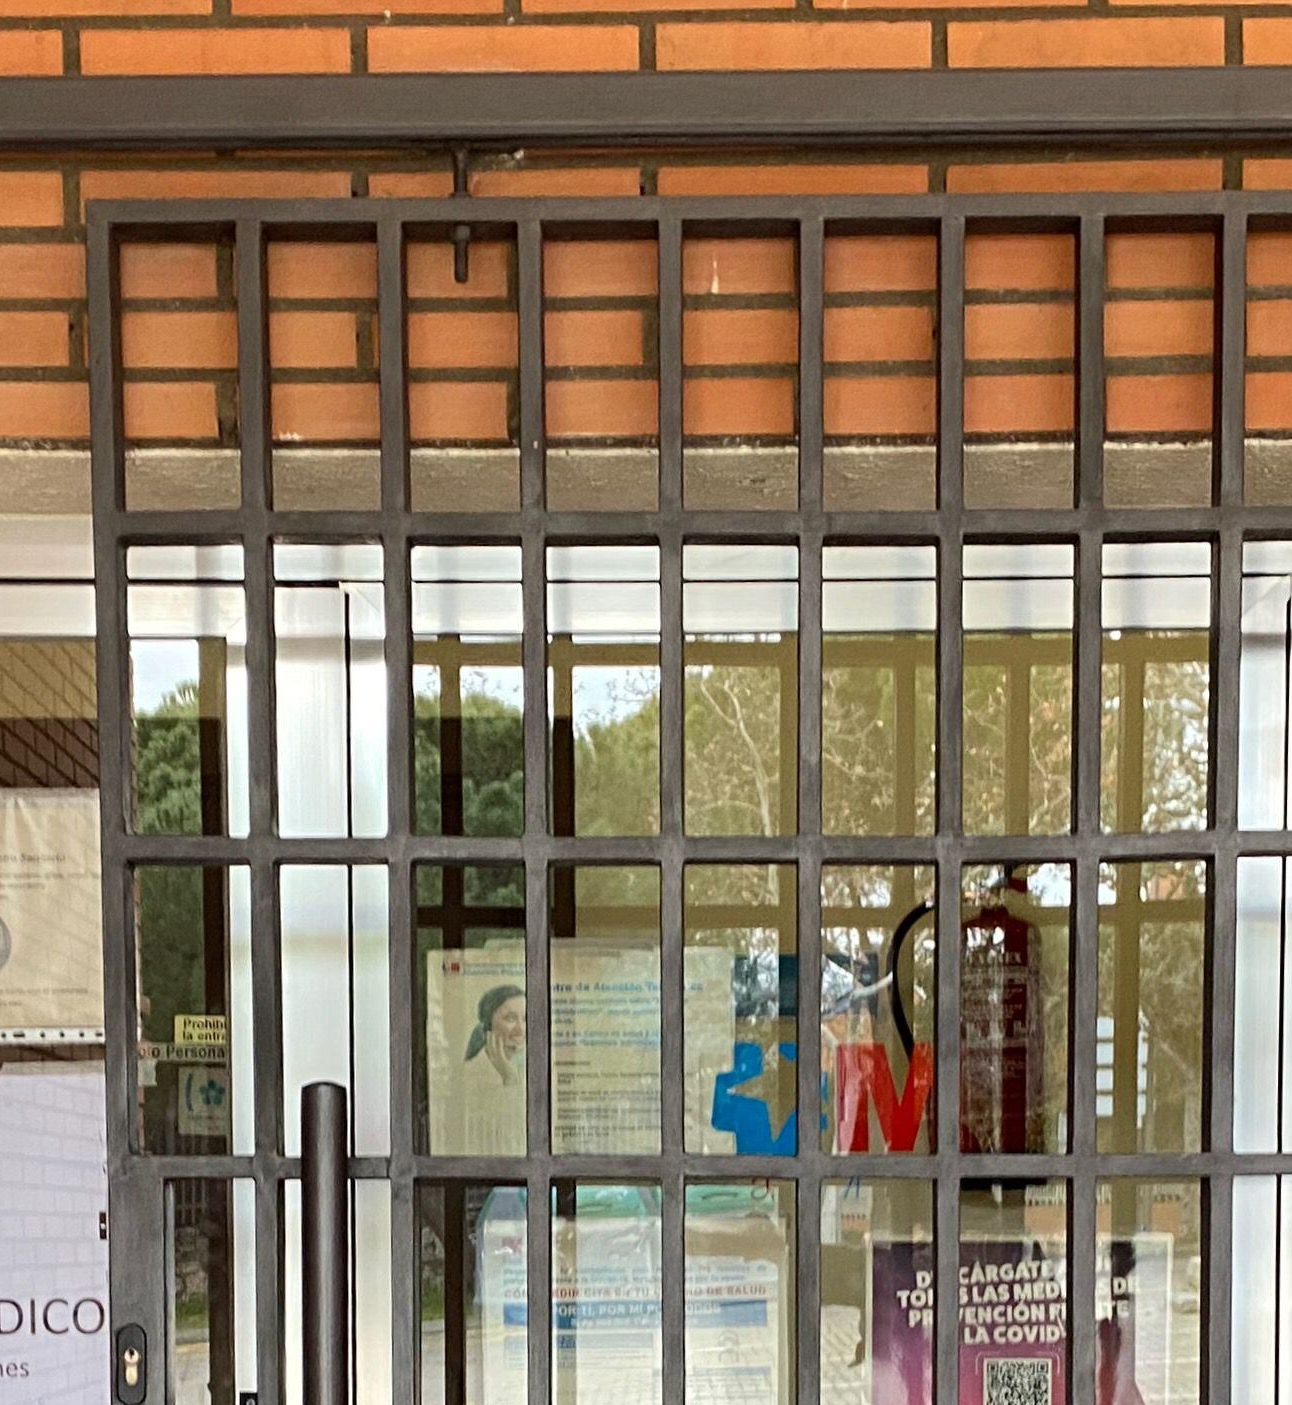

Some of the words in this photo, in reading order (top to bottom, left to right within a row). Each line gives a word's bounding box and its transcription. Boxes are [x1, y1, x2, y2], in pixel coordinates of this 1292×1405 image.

[972, 1282, 1010, 1303] LAS
[964, 1325, 990, 1345] LA
[993, 1323, 1059, 1345] COVID
